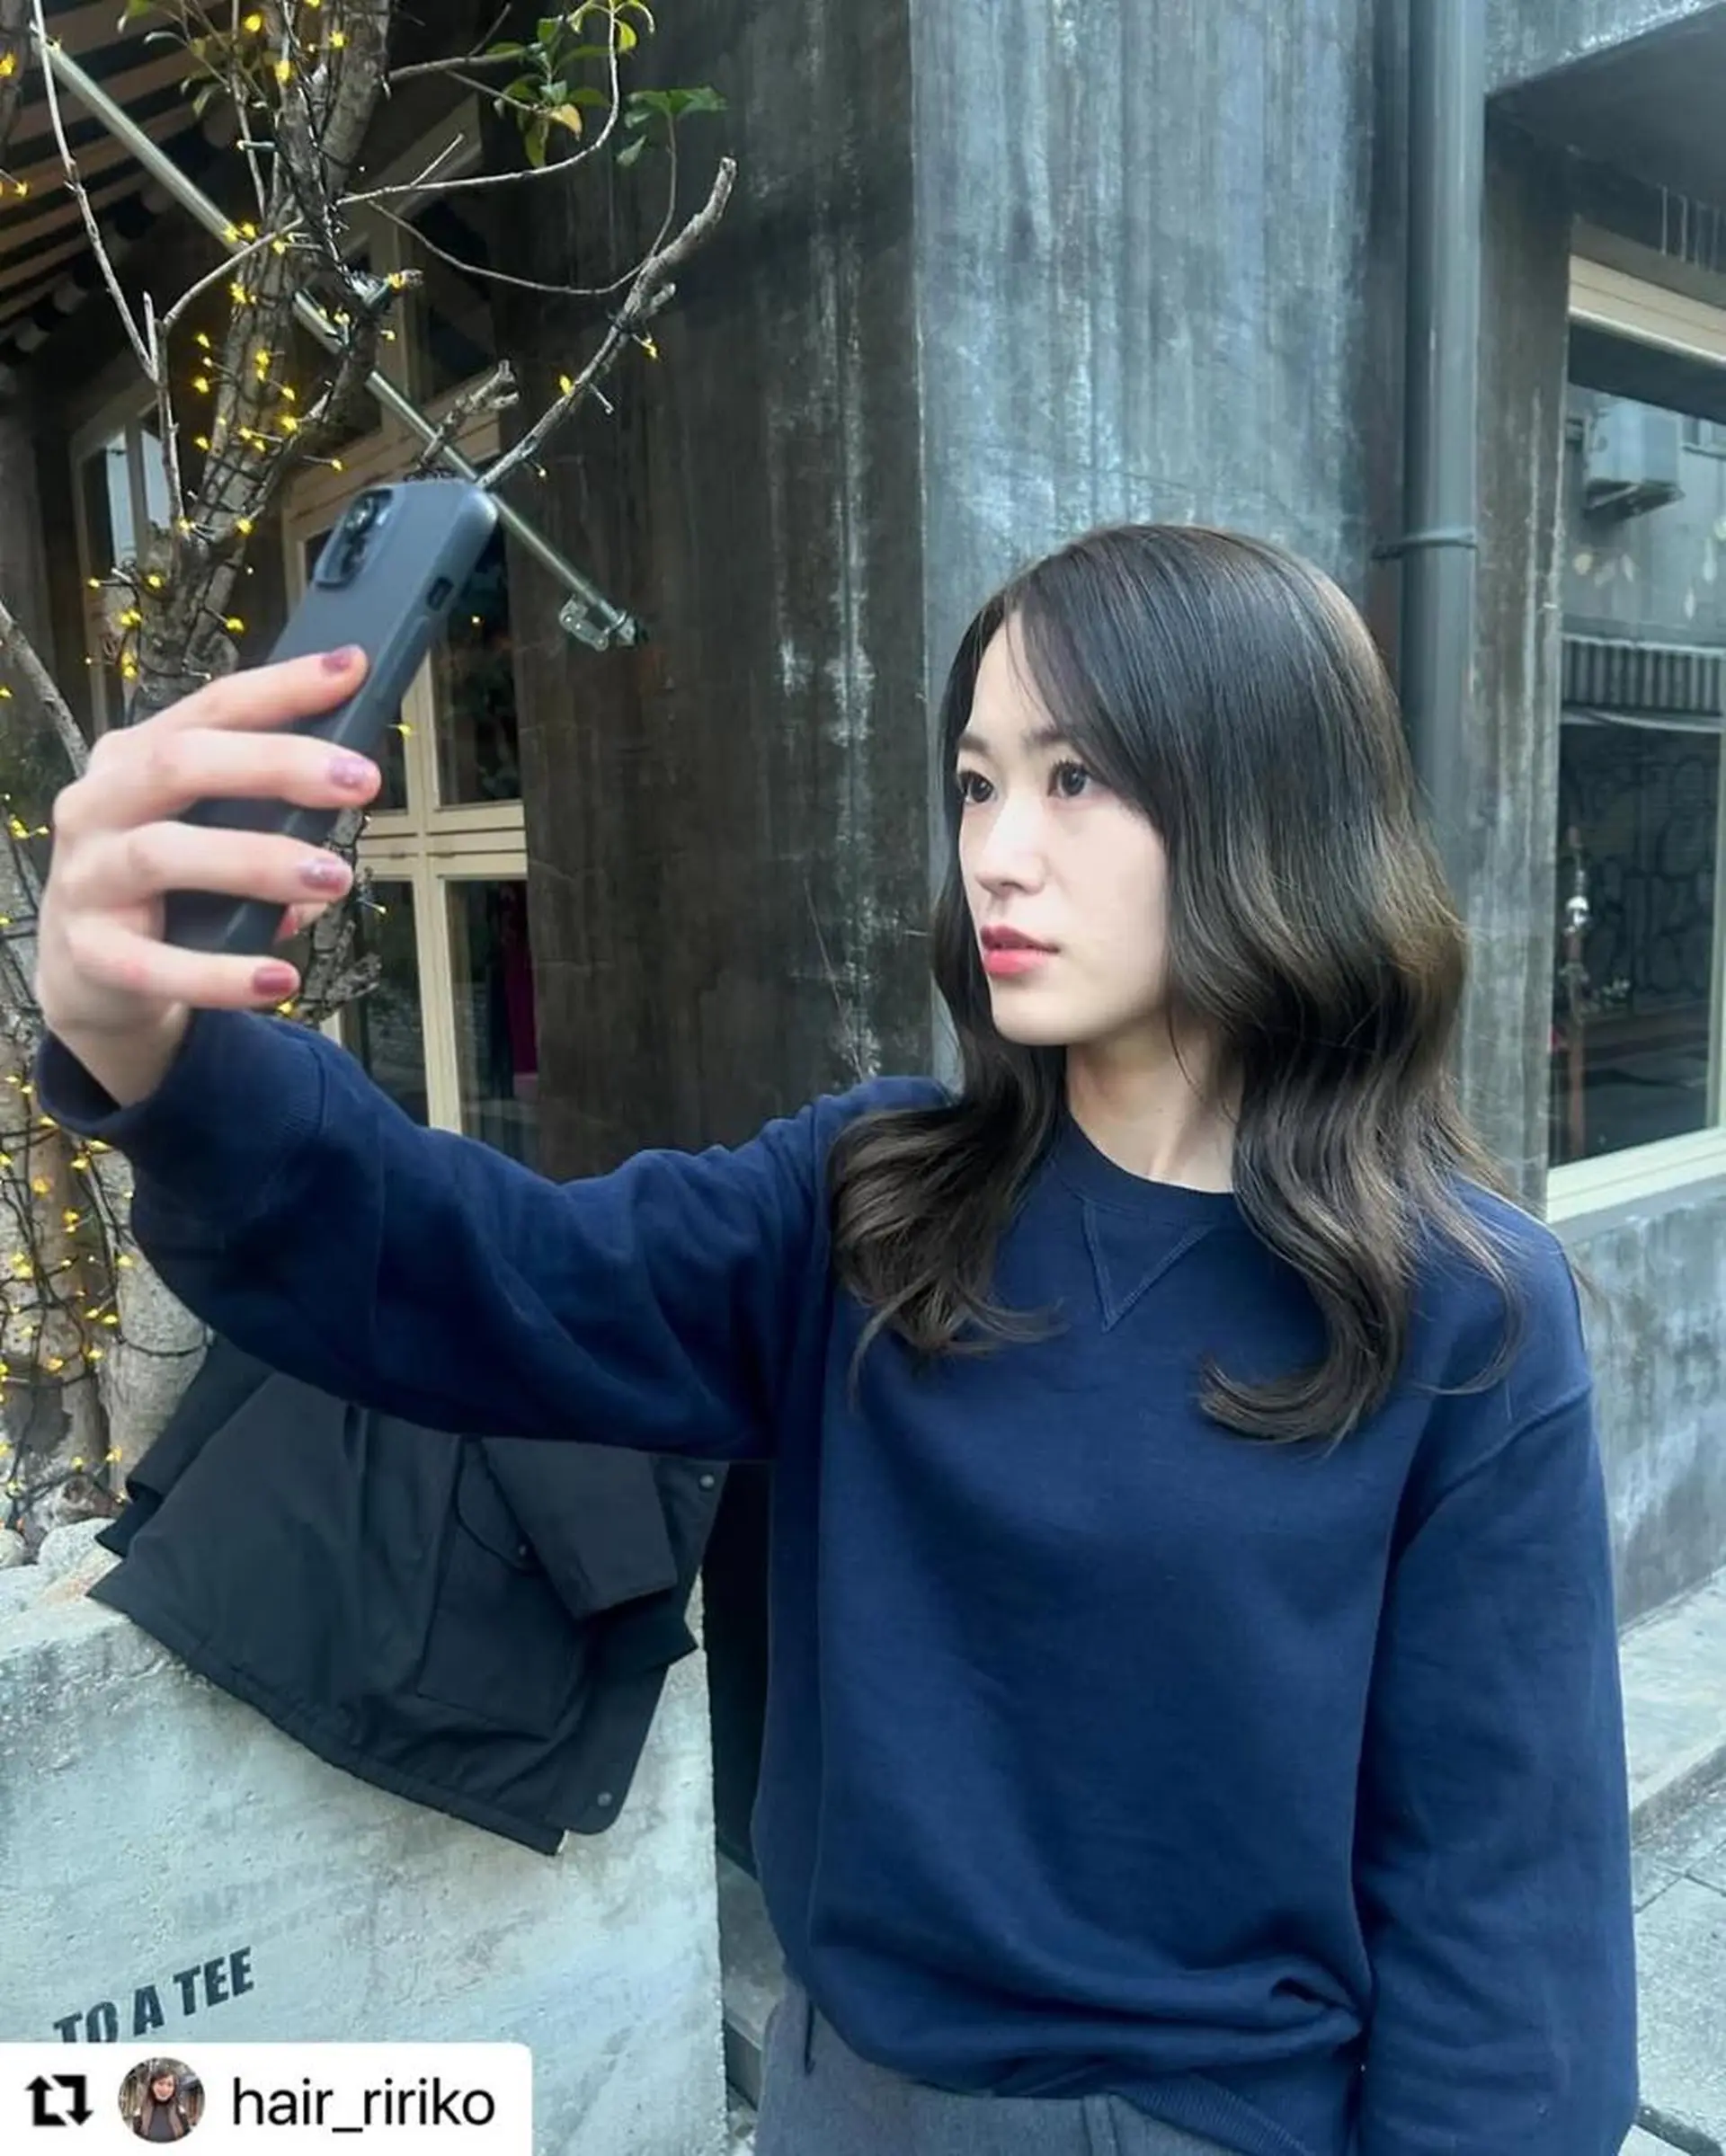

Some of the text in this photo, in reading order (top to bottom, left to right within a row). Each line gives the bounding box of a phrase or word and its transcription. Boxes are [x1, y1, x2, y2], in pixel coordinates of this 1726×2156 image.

[53, 1947, 254, 2043] TO A TEE
